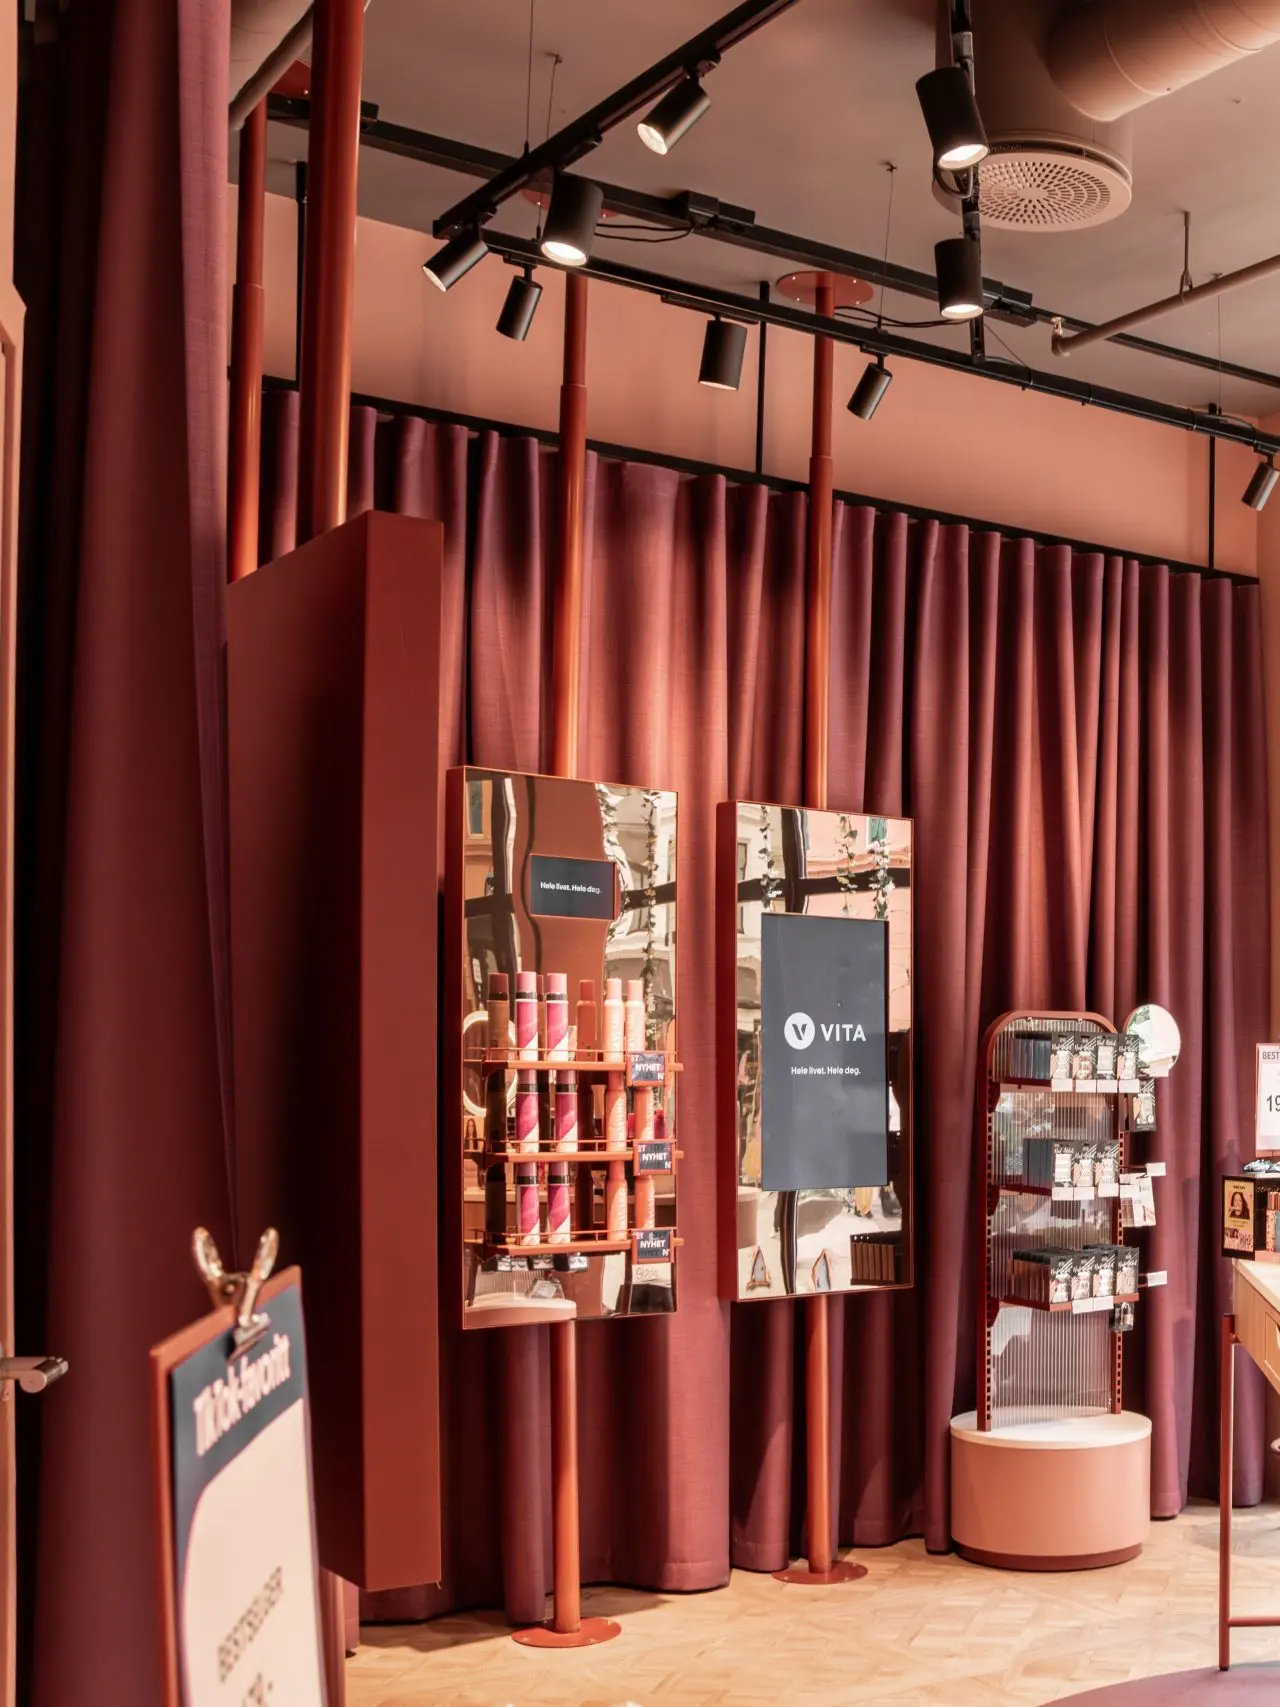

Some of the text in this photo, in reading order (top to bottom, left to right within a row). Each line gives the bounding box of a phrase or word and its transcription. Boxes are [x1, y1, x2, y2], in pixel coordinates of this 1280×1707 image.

[820, 1023, 867, 1042] VITA
[635, 1063, 661, 1072] NYHET
[791, 1066, 808, 1075] Hele
[808, 1066, 826, 1075] livet.
[827, 1066, 844, 1075] Hele
[642, 1152, 668, 1161] NYHET
[640, 1239, 665, 1248] NYHET
